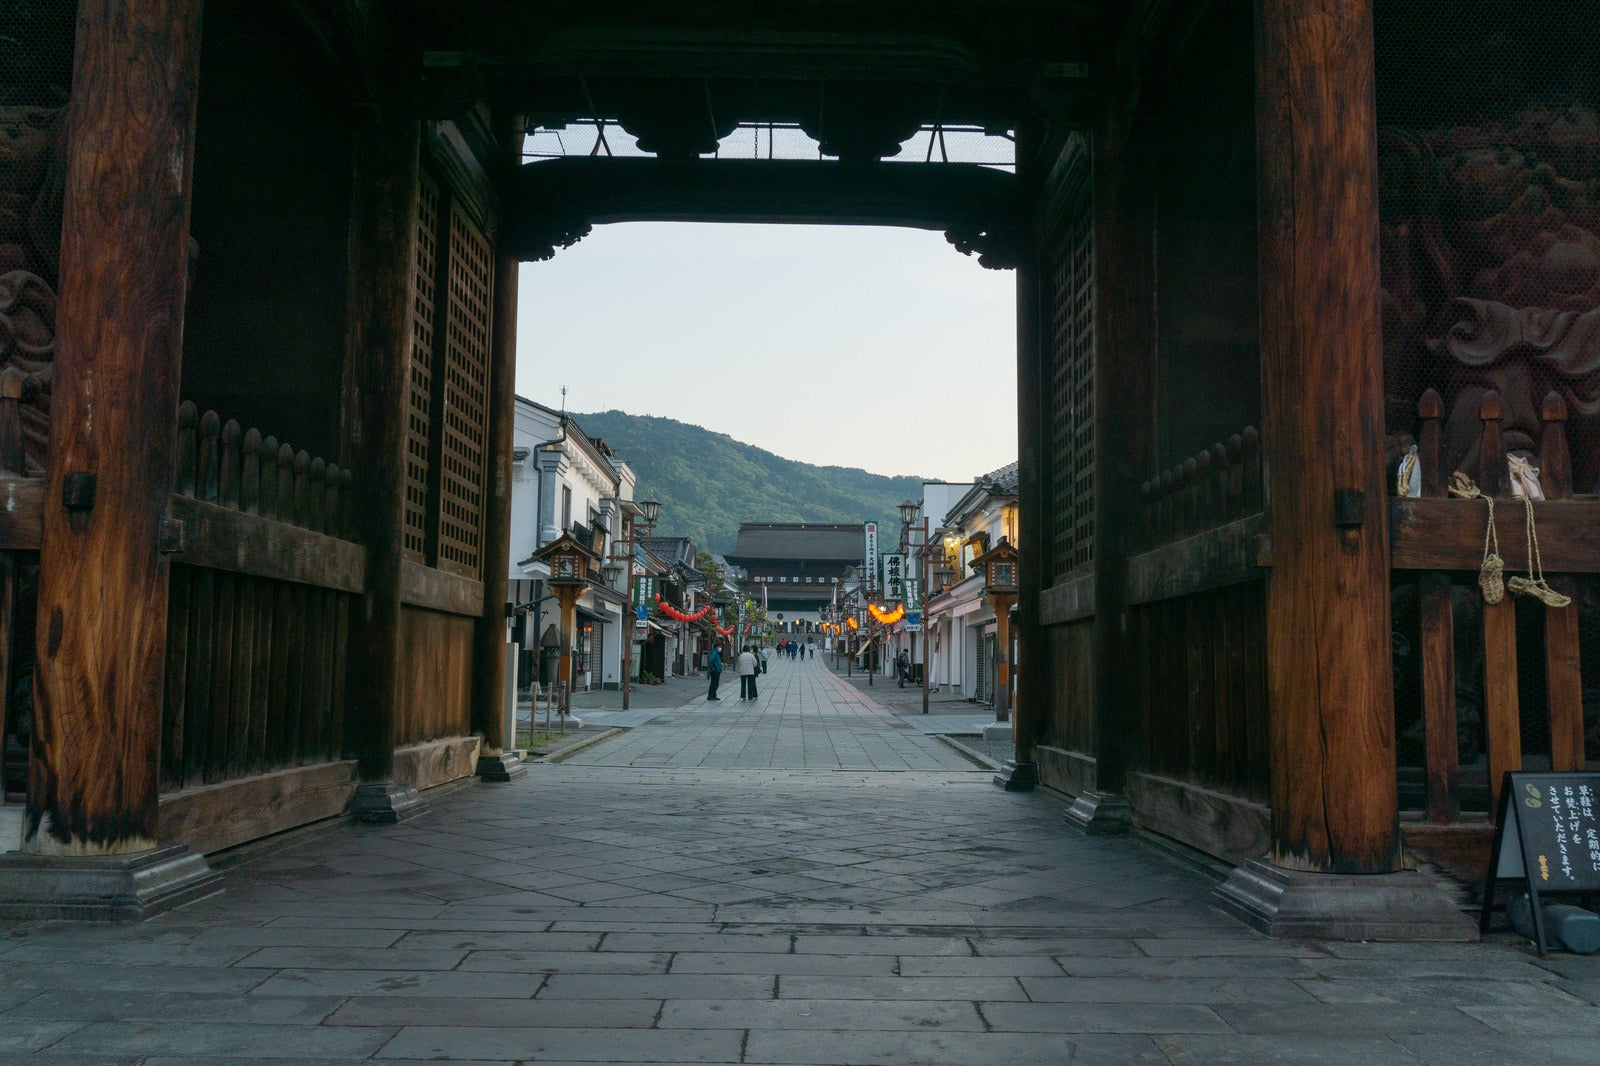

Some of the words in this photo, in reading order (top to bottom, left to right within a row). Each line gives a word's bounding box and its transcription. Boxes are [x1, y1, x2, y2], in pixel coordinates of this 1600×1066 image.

[1548, 785, 1575, 881] させていただきます。
[1563, 785, 1582, 844] お焚上げを
